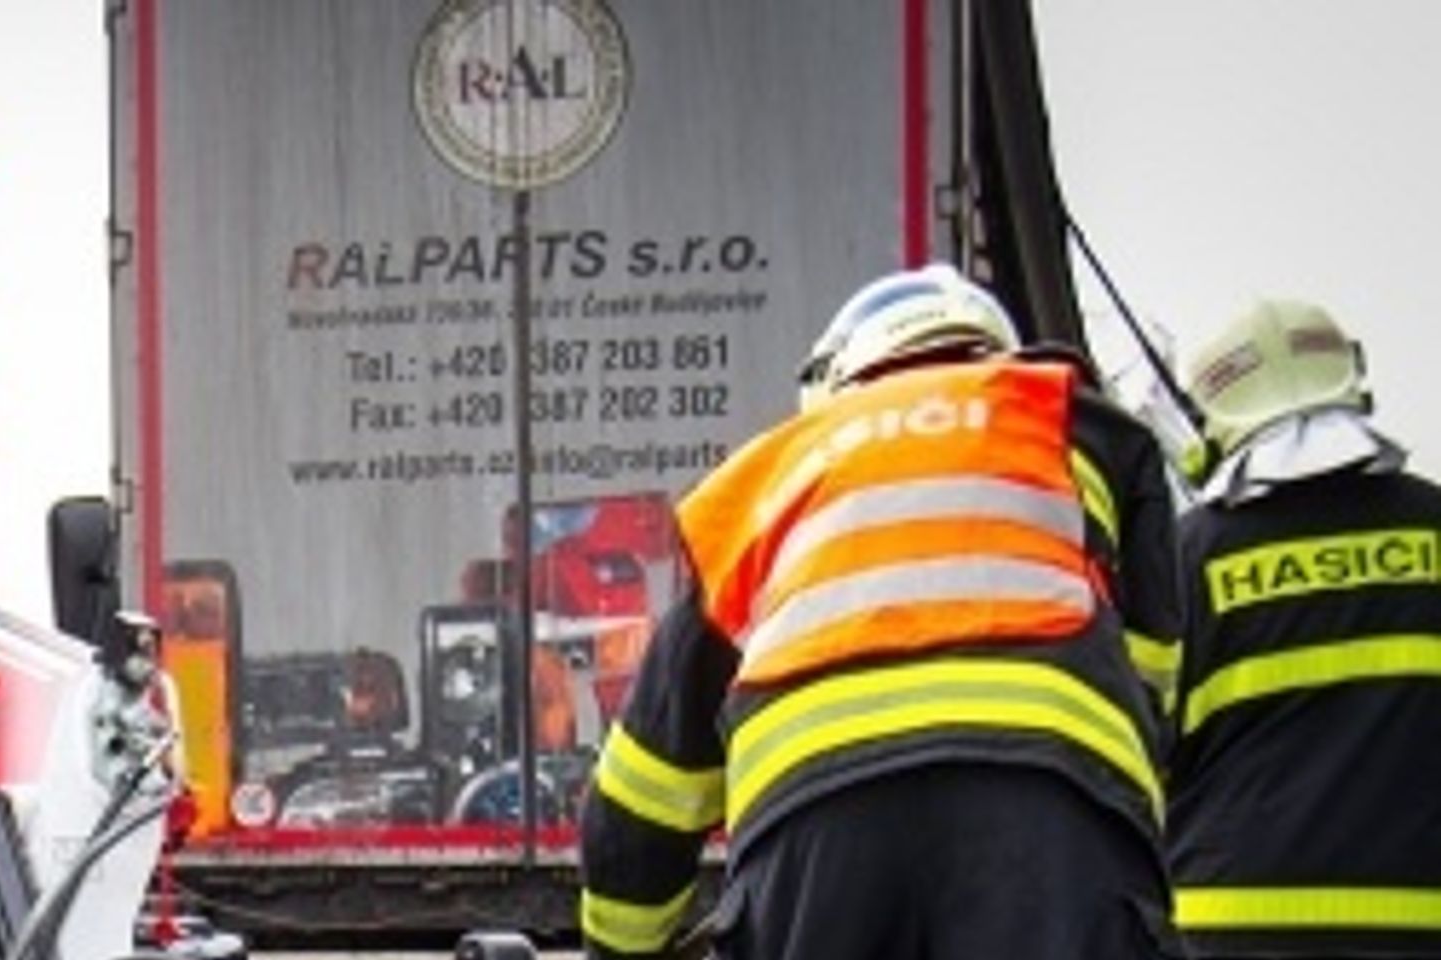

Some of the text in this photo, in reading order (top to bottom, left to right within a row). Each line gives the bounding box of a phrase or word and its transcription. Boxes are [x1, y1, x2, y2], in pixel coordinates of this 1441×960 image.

[627, 235, 769, 277] s.r.o.
[427, 342, 507, 380] +420
[603, 338, 661, 371] 203
[427, 390, 503, 428] +420
[669, 383, 730, 418] 302
